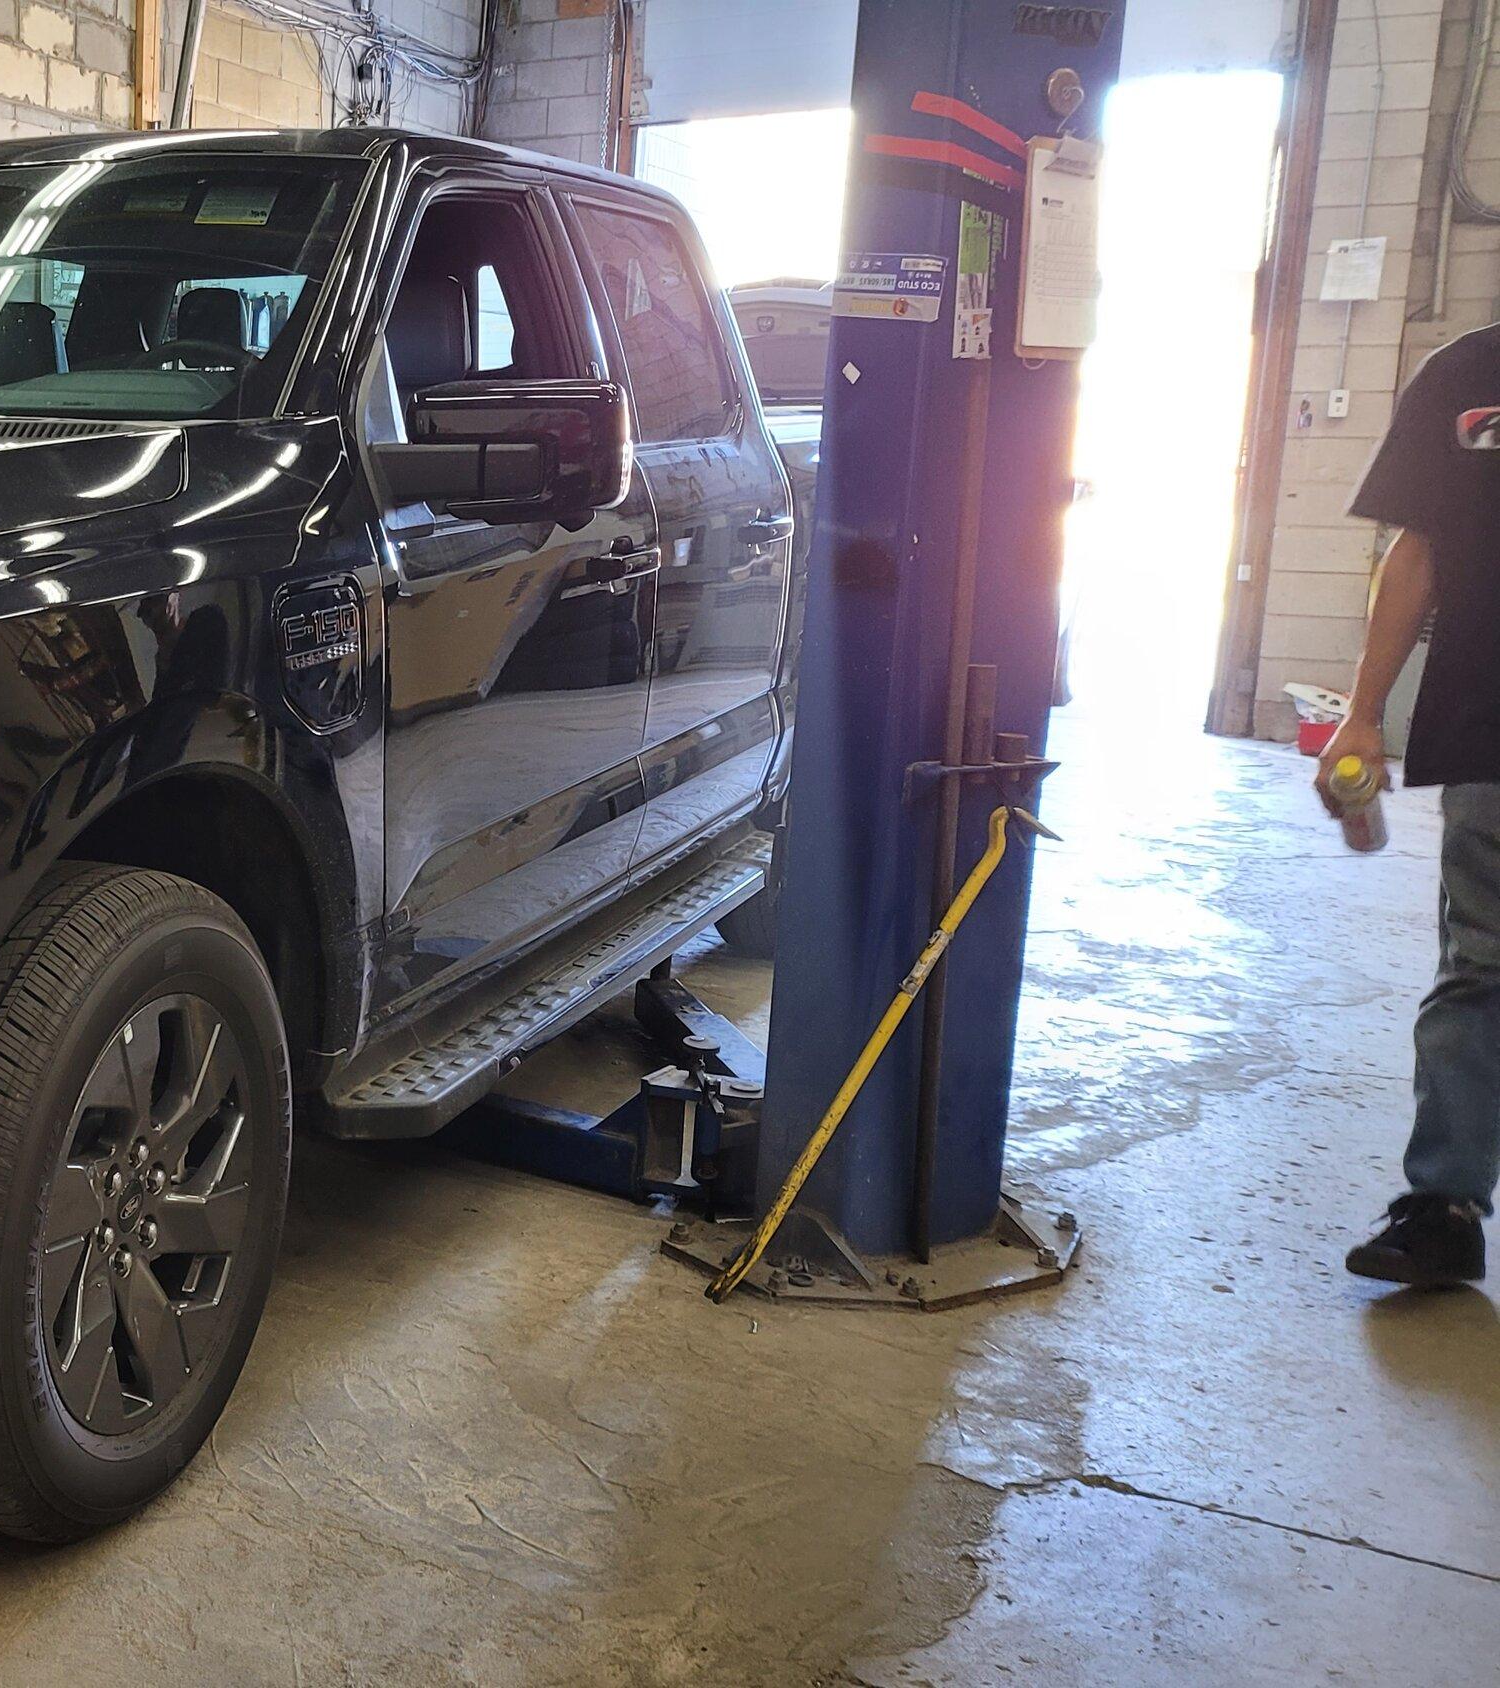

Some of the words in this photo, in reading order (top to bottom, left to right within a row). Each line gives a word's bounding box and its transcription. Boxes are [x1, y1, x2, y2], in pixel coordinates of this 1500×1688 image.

[897, 280, 919, 289] STUD
[920, 281, 941, 291] ECO
[280, 602, 360, 652] F-150
